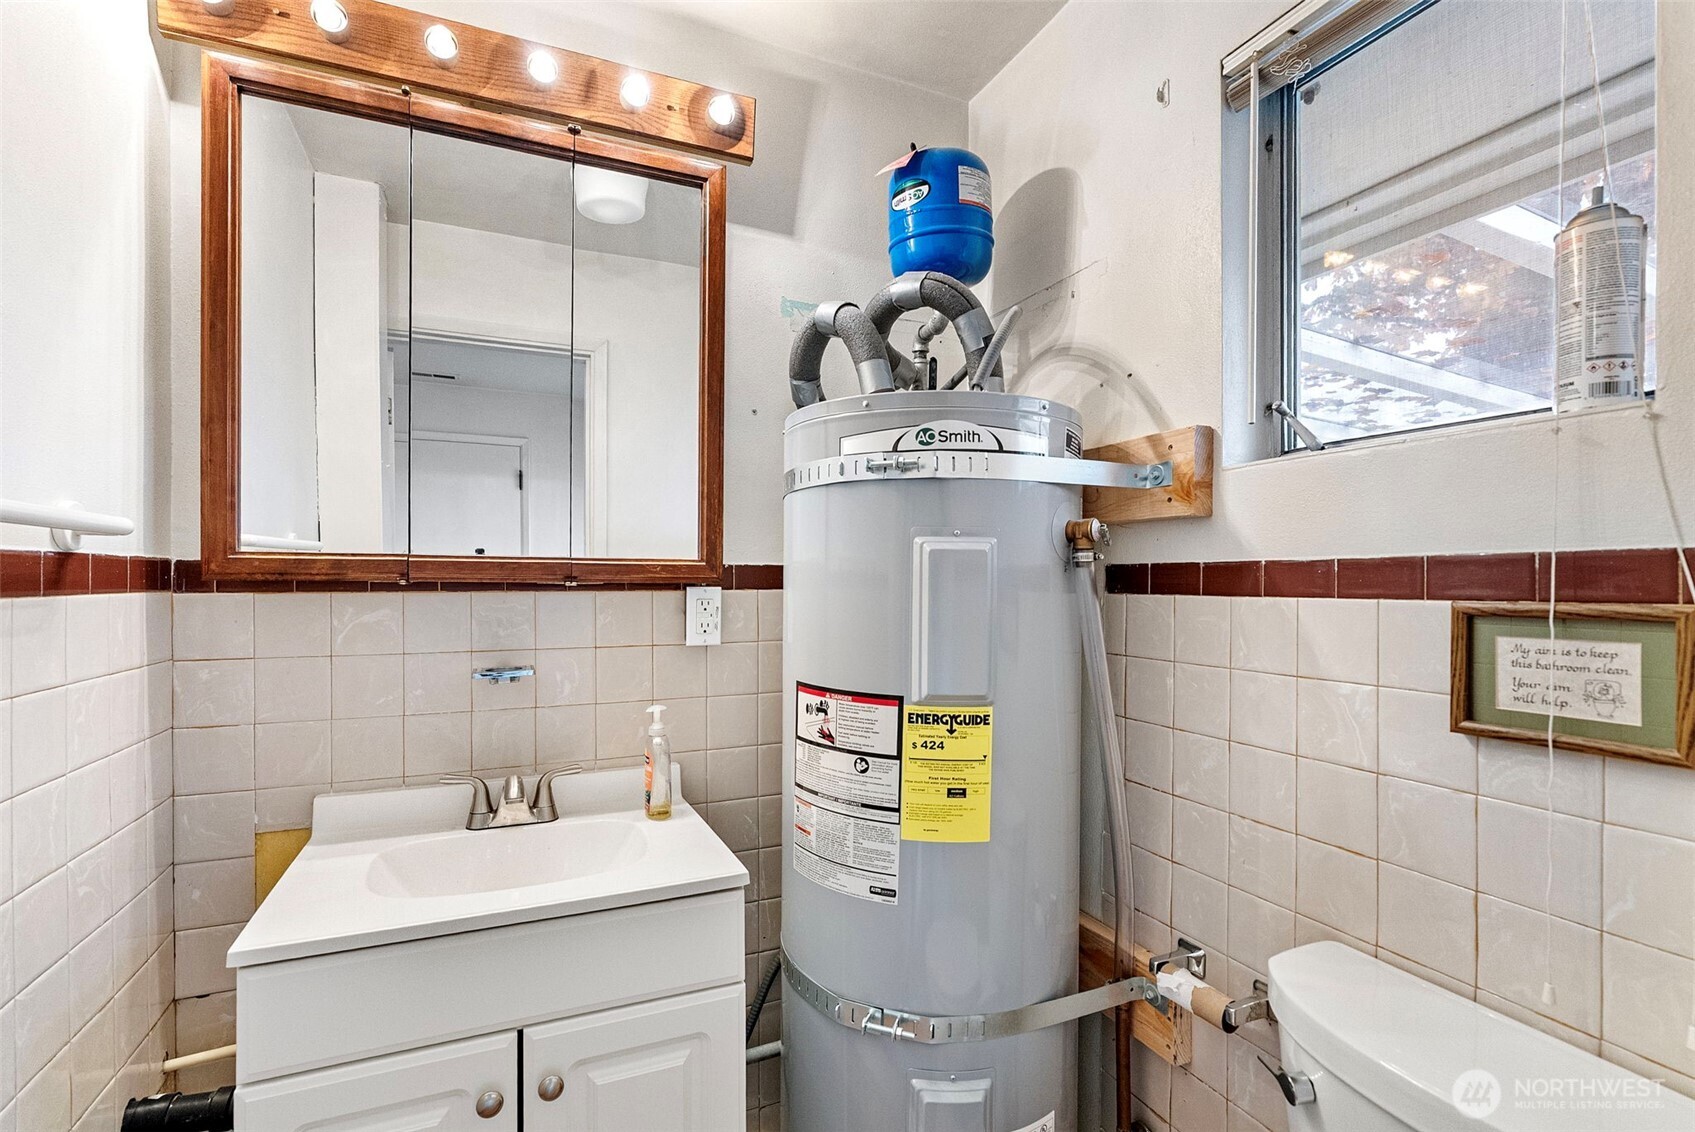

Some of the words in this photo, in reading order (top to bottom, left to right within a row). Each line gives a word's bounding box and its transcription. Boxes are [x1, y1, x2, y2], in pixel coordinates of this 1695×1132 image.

[1510, 644, 1530, 659] My
[1561, 648, 1571, 656] is
[1574, 648, 1587, 658] to
[1590, 646, 1618, 664] keep
[1512, 658, 1532, 668] this
[1512, 676, 1541, 692] Your
[1513, 692, 1536, 704] will
[920, 741, 945, 750] 424
